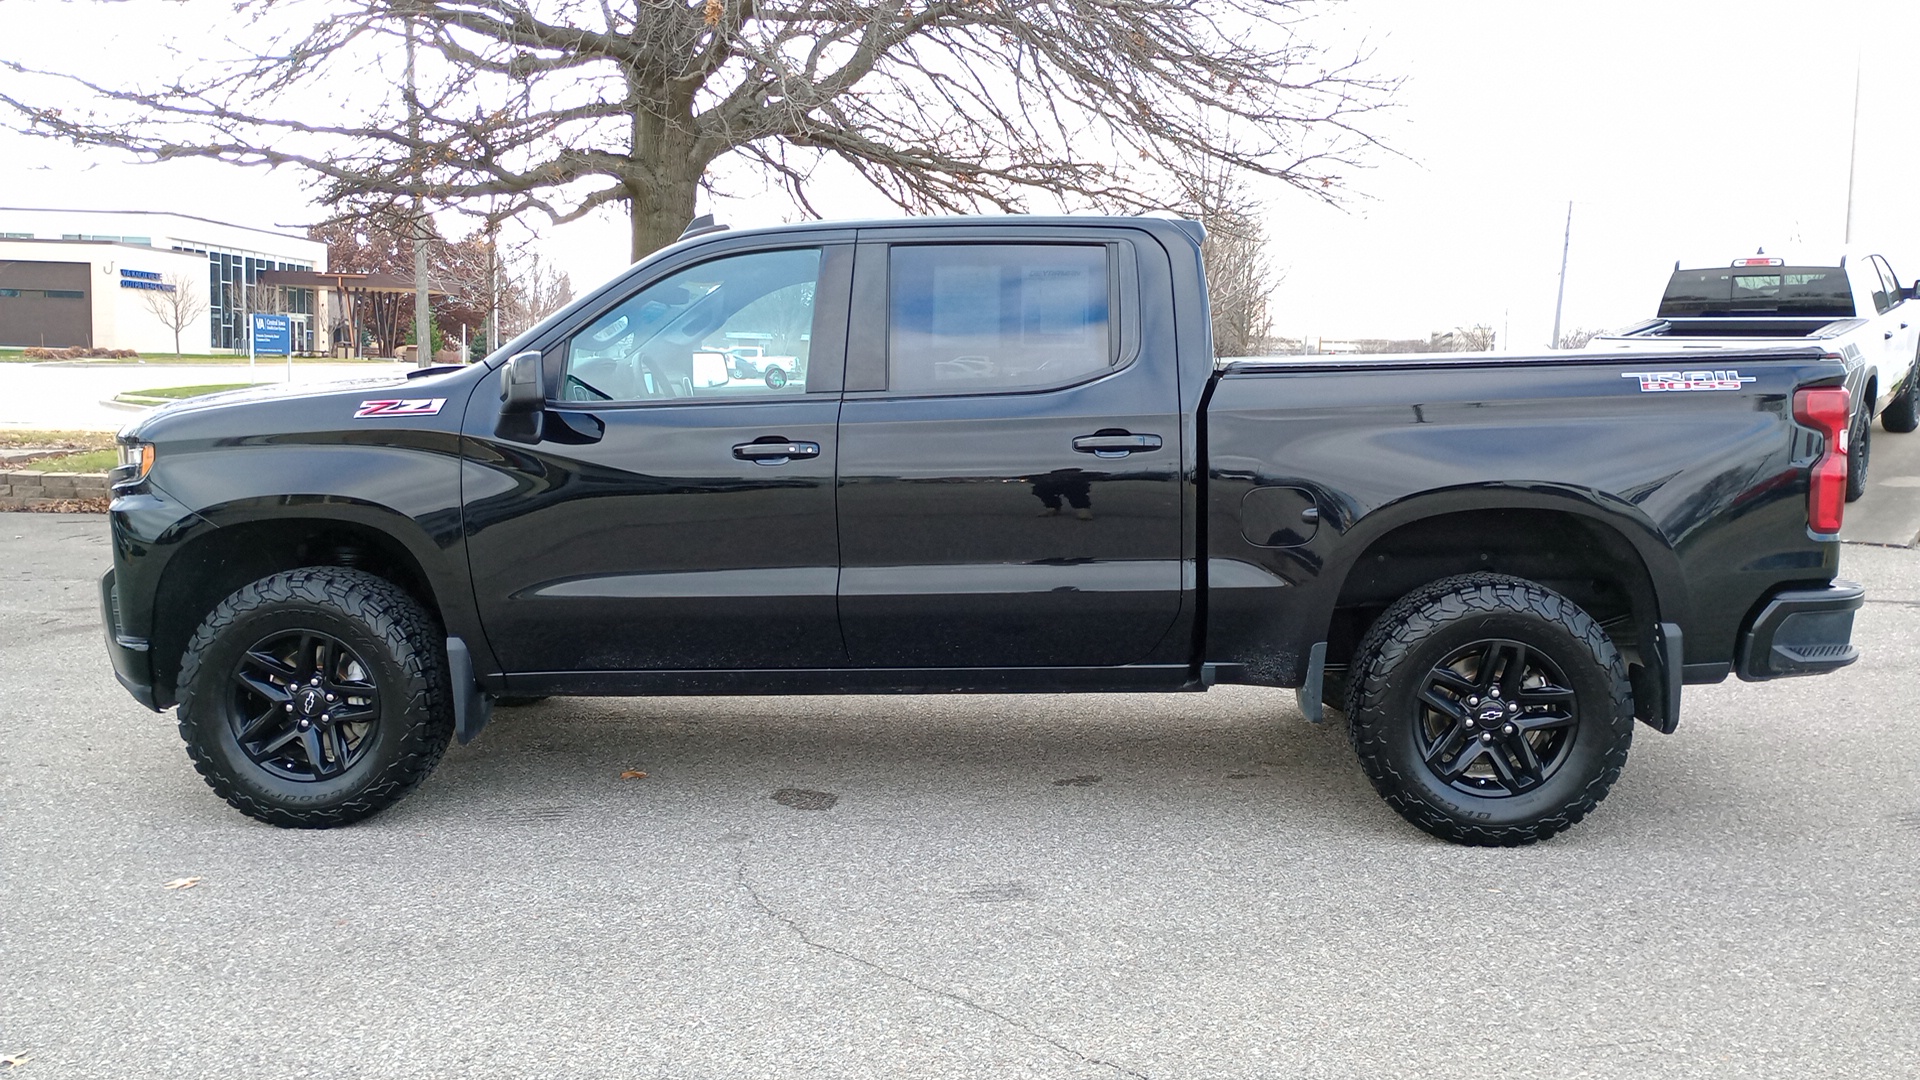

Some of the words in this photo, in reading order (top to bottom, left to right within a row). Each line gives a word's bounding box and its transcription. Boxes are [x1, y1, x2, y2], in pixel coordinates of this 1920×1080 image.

[256, 317, 265, 330] VA
[1621, 370, 1757, 382] TRAIL
[1640, 381, 1741, 392] BOSS
[353, 398, 448, 419] Z71
